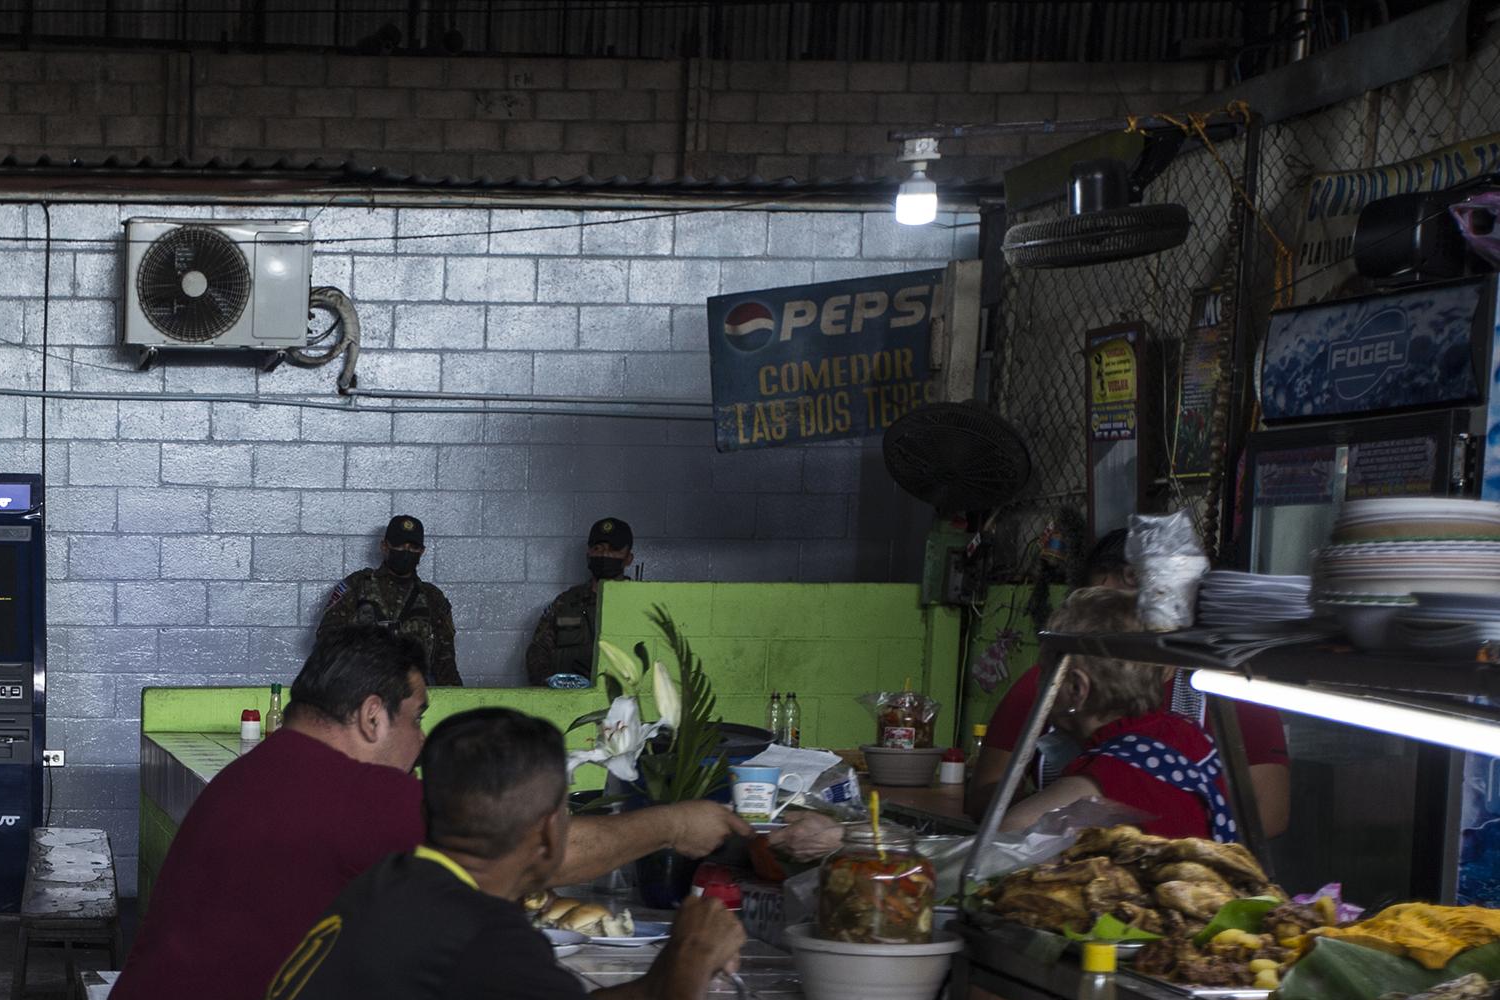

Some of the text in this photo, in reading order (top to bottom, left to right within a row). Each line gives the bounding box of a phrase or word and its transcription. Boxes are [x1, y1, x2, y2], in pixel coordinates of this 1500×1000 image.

[758, 347, 914, 396] COMEDOR
[1331, 341, 1404, 370] FOGEL
[734, 400, 789, 445] LAS
[799, 391, 853, 437] DOS
